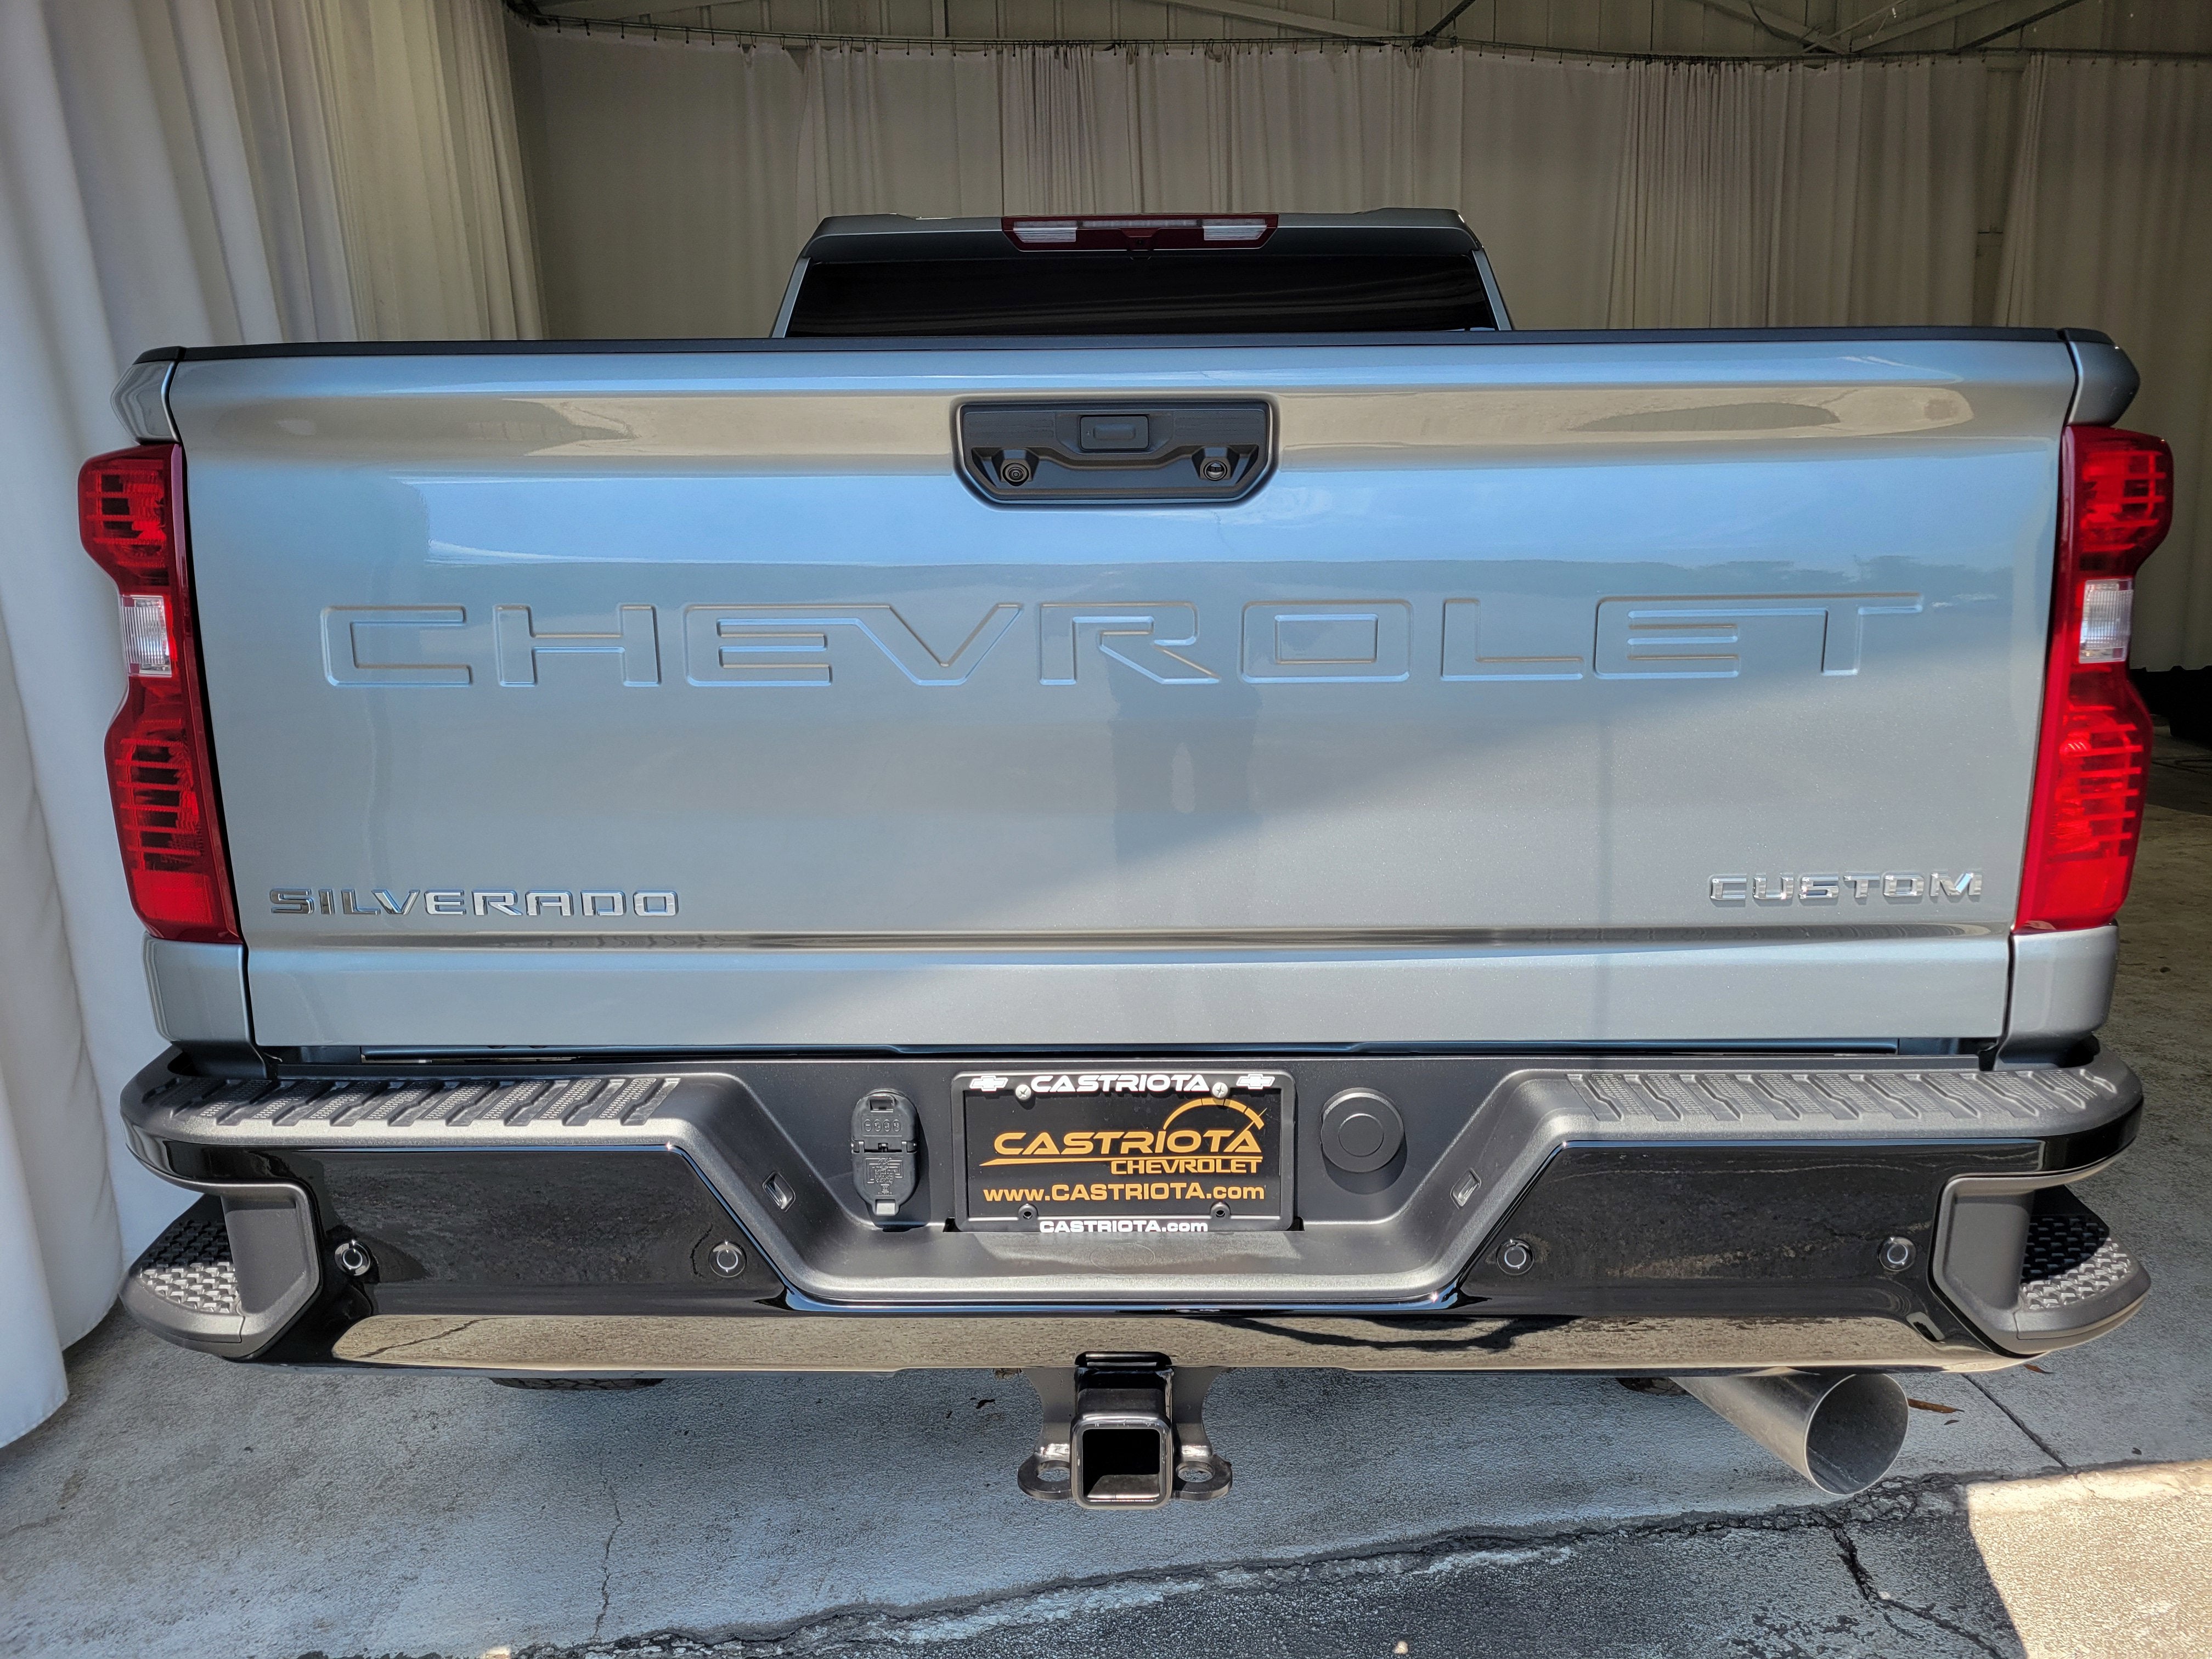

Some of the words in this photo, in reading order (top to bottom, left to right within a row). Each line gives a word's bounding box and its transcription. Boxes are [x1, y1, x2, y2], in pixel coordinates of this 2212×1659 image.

[320, 592, 1923, 689] CHEVROLET
[1709, 872, 1983, 900] CUSTOM
[269, 888, 679, 917] SILVERADO
[1031, 1074, 1210, 1092] CASTRIOTA
[994, 1130, 1262, 1155] CASTRIOTA
[1110, 1159, 1262, 1175] CHEVROLET
[983, 1183, 1265, 1201] www.CASTRIOTA.com
[1039, 1220, 1209, 1233] CASTRIOTA.com
